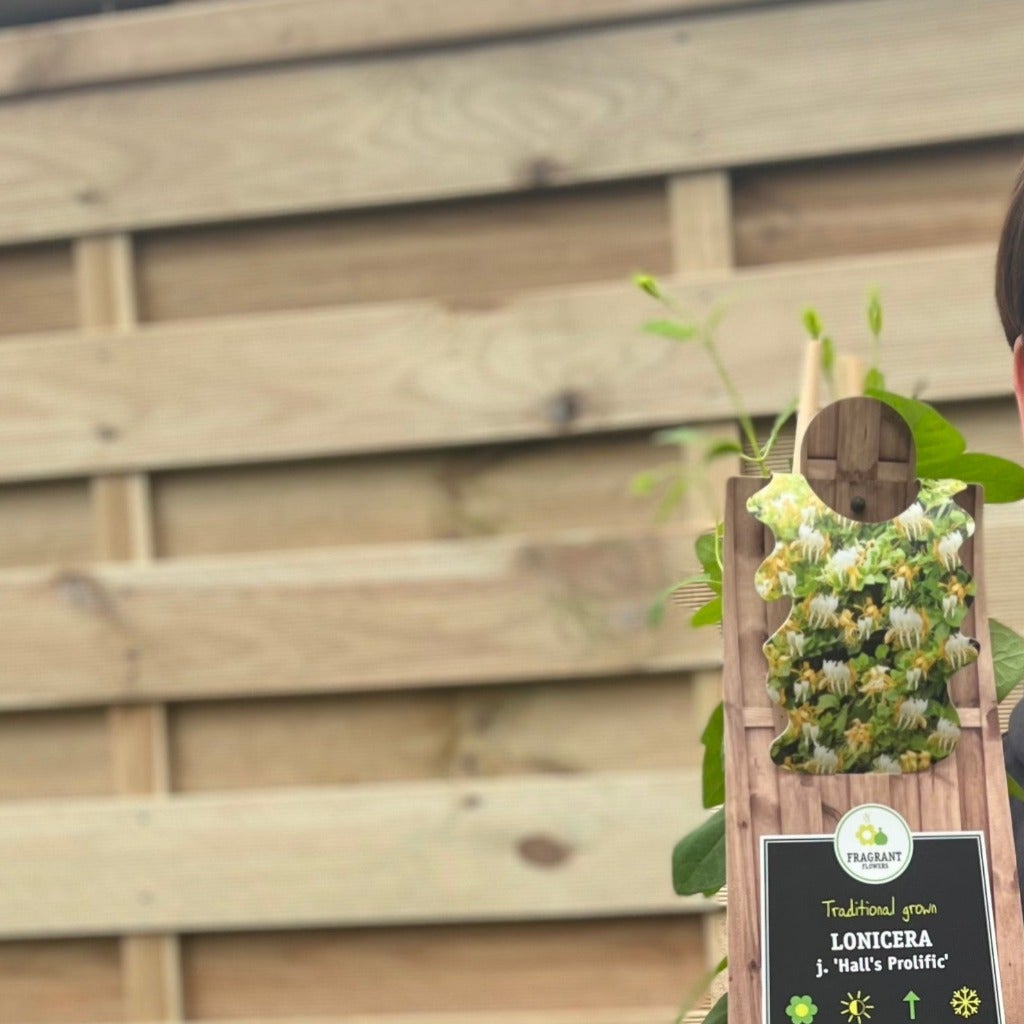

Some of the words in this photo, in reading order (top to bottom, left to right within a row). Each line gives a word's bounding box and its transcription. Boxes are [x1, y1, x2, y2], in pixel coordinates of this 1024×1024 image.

[847, 851, 902, 863] FRAGRANT
[821, 896, 895, 918] Traditional
[902, 902, 938, 922] grown
[830, 929, 933, 951] LONICERA
[815, 958, 829, 978] j.
[887, 953, 949, 971] Prolific'
